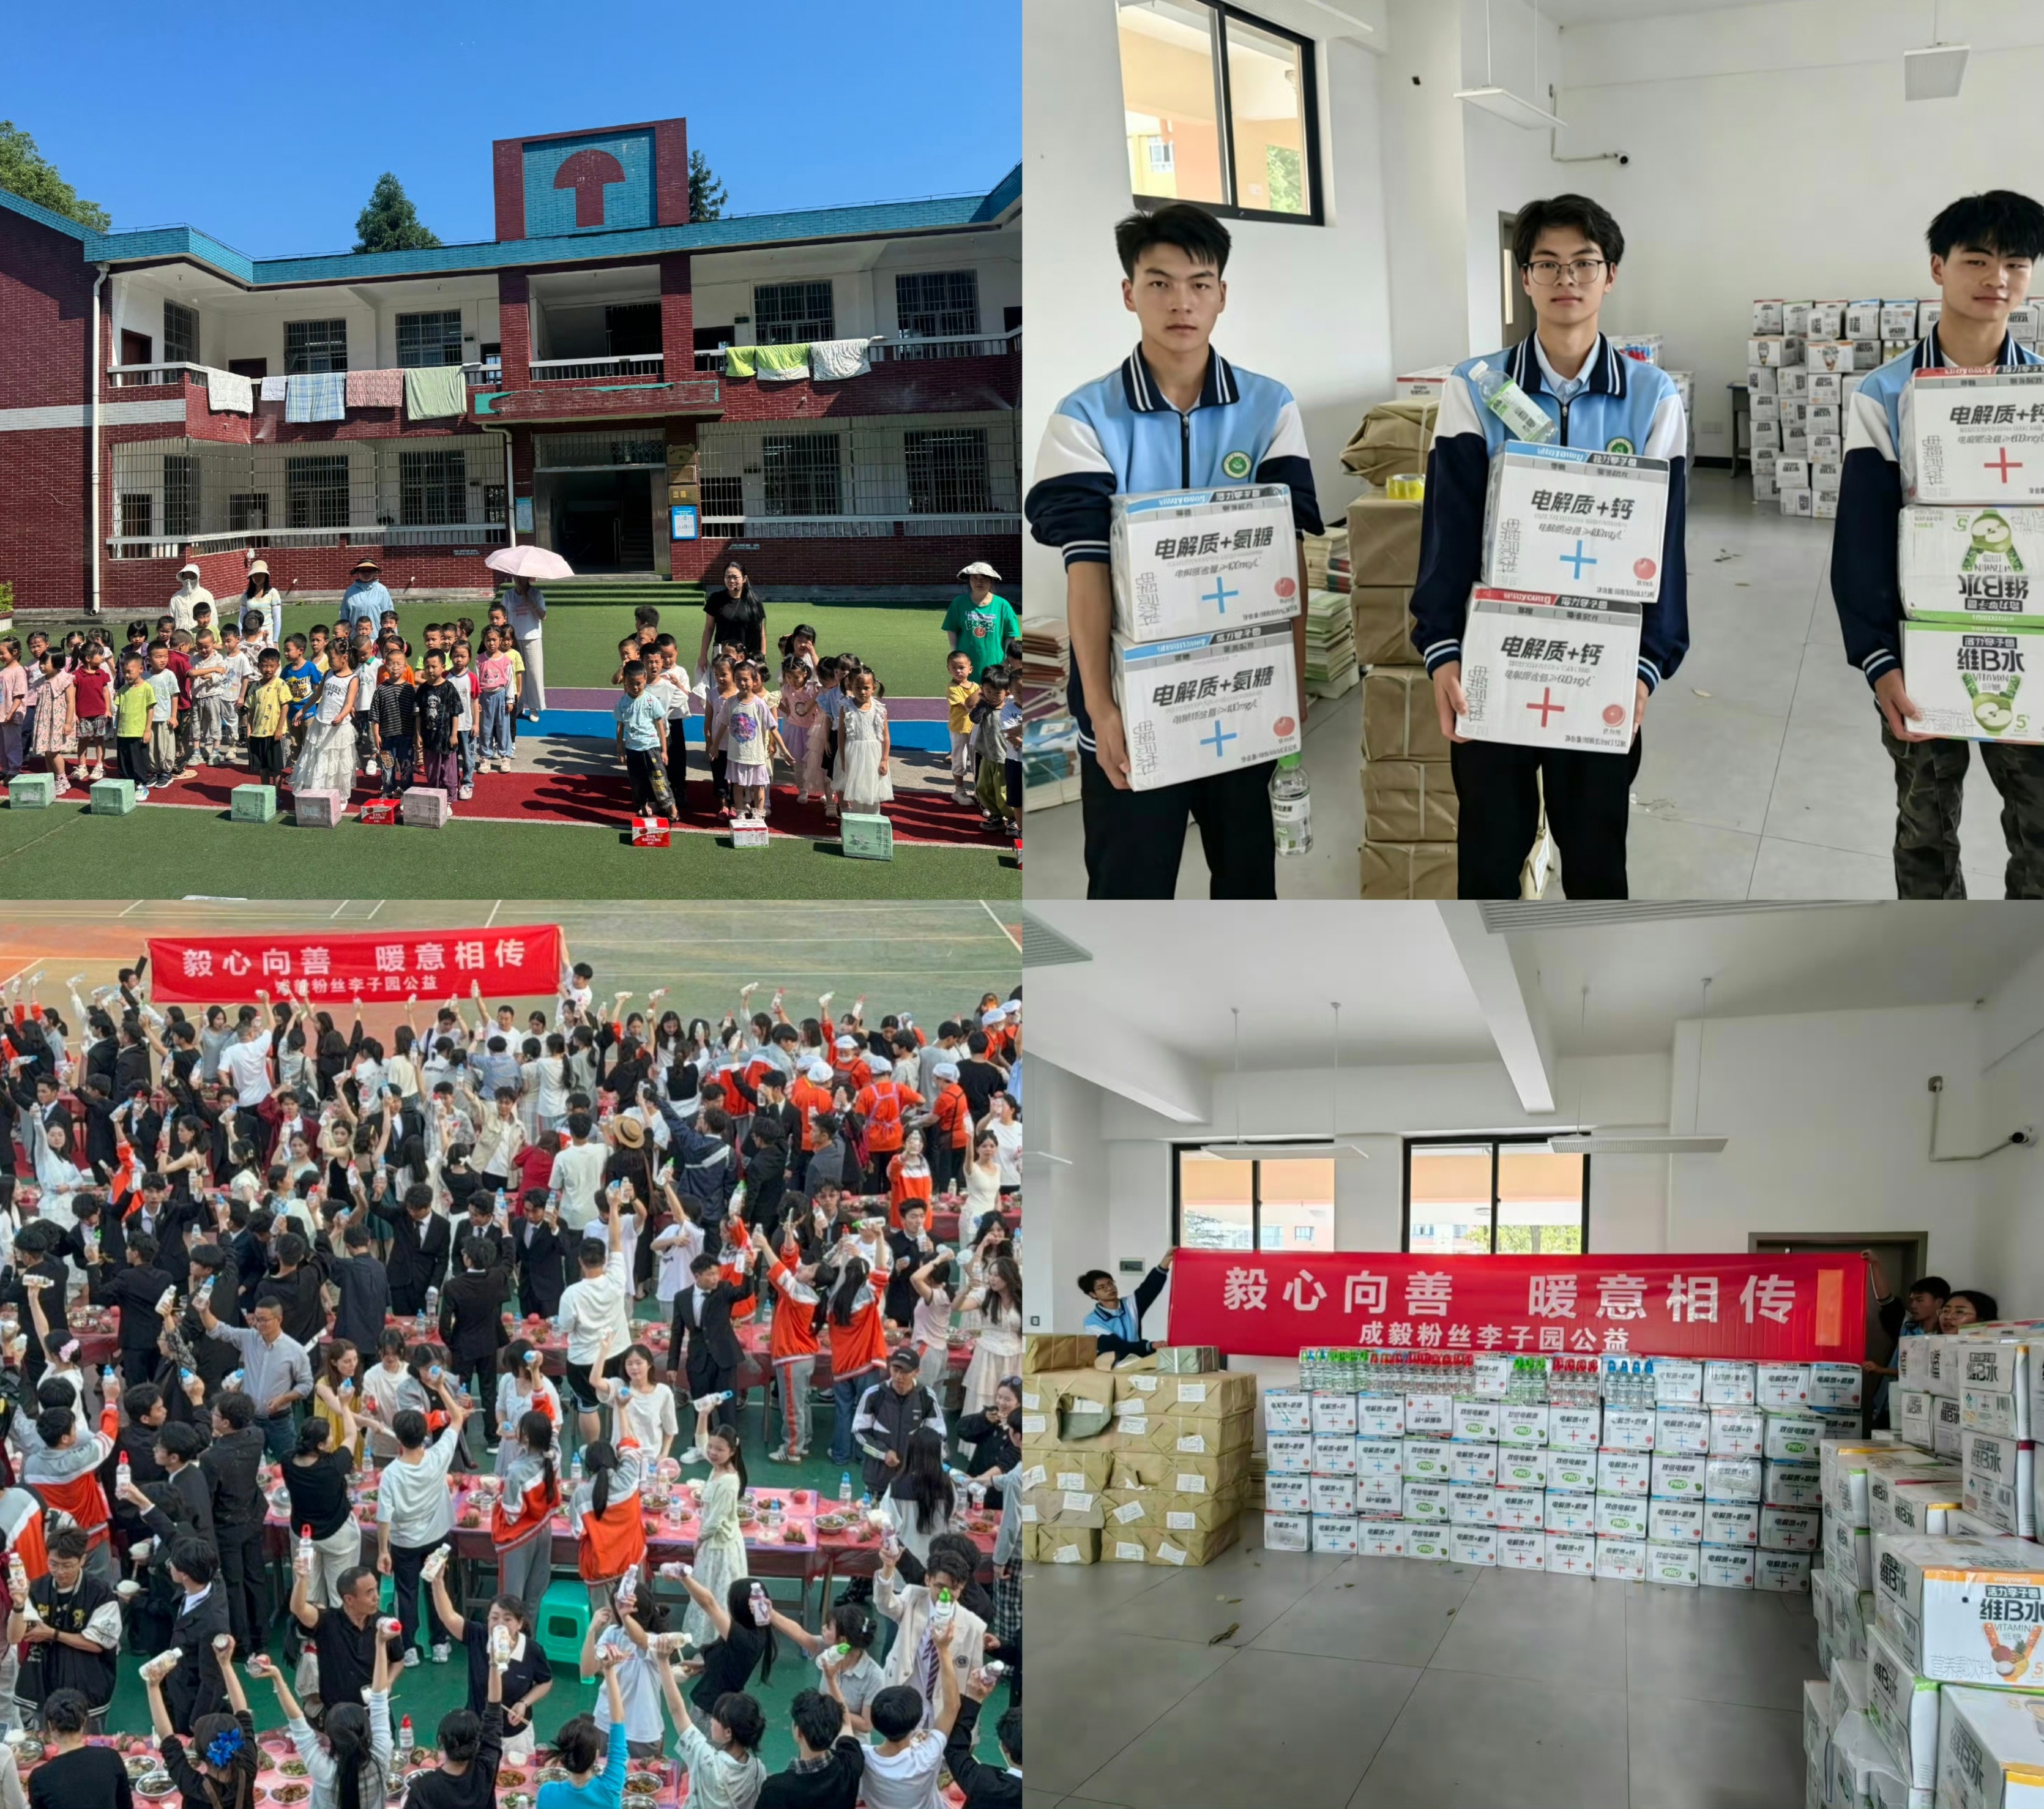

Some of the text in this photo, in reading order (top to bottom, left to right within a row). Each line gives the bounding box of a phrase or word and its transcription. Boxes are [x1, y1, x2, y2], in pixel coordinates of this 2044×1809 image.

[1531, 489, 1636, 520] 电解质+钙
[1154, 526, 1274, 560] 电解质+氨糖
[1958, 574, 2029, 599] 维B水
[1500, 635, 1604, 666] 电解质+钙
[1956, 647, 2025, 672] 维B水
[1152, 665, 1274, 707] 电解质+氨糖
[182, 939, 526, 978] 毅心向善 暖意相传
[1223, 1267, 1799, 1324] 毅心向善 暖意相传
[1358, 1321, 1630, 1352] 成毅粉丝李子园公益
[1515, 1427, 1530, 1435] PRO
[1787, 1442, 1805, 1452] PRO
[1418, 1461, 1433, 1470] PRO
[1515, 1469, 1529, 1478] PRO
[1669, 1480, 1687, 1489] PRO
[1417, 1503, 1432, 1512] PRO
[1612, 1519, 1628, 1527] PRO
[1663, 1568, 1680, 1577] PRO
[1993, 1575, 2031, 1584] vitayoung
[1987, 1587, 2040, 1598] 活力李子园
[1980, 1598, 2044, 1622] 维B水
[1994, 1623, 2032, 1632] VITAMIN
